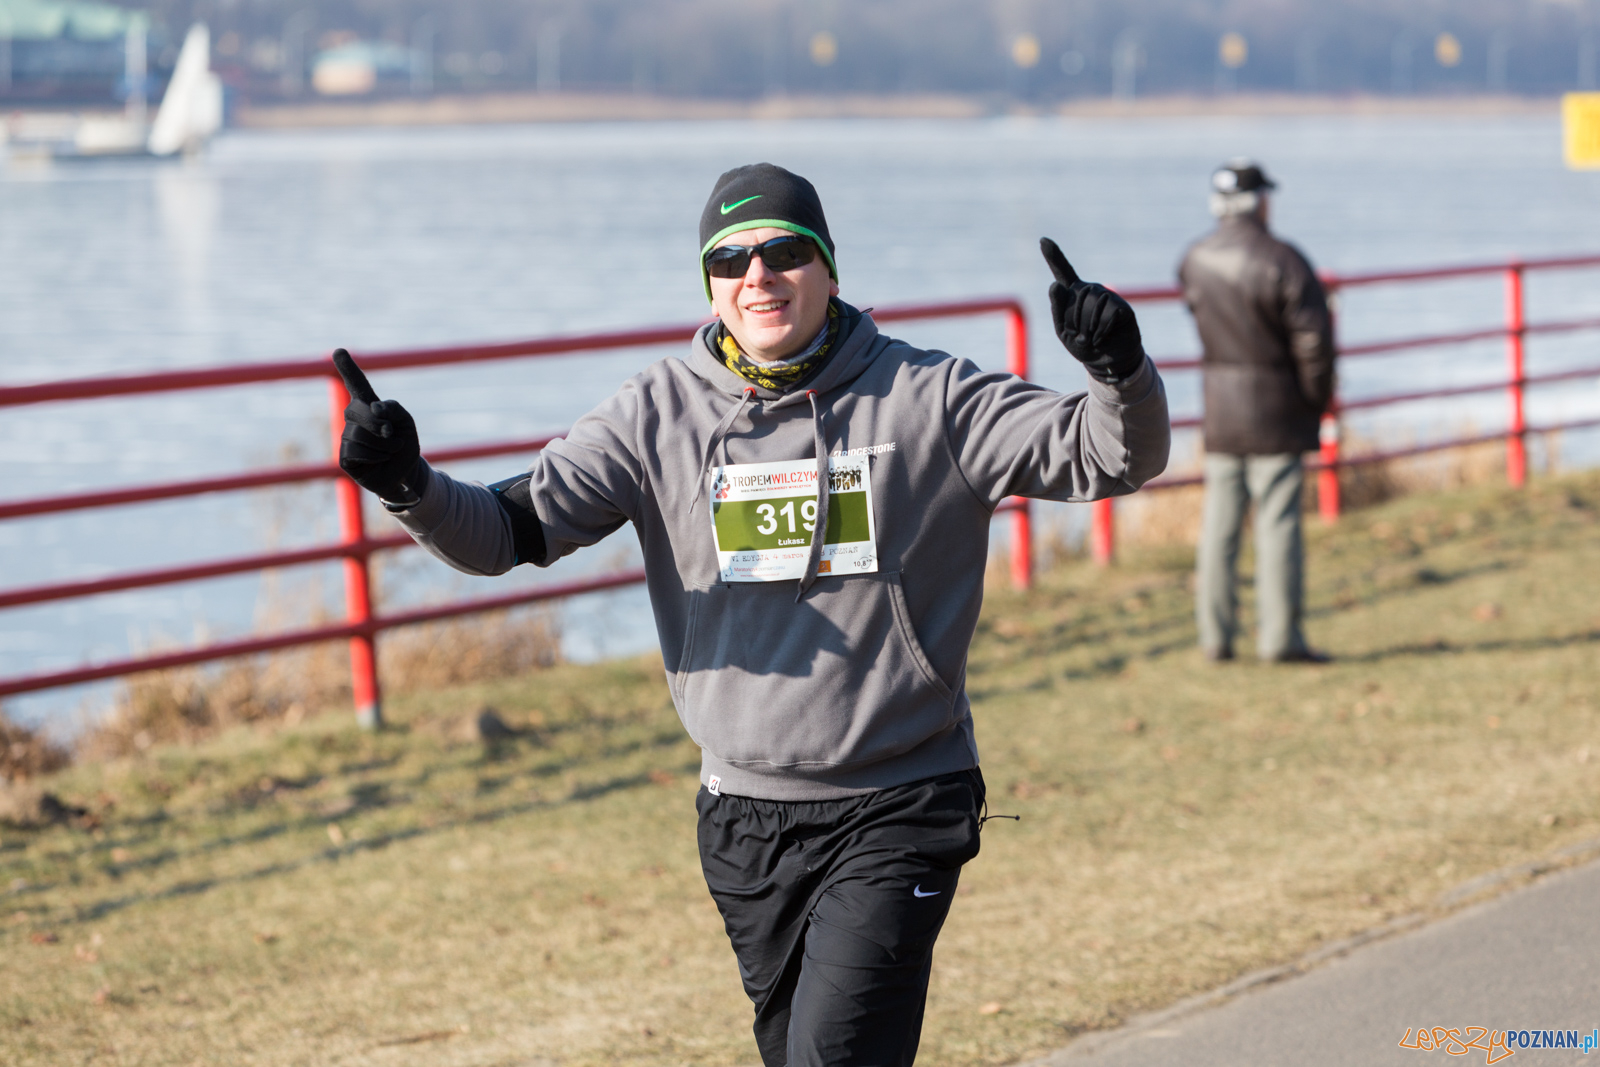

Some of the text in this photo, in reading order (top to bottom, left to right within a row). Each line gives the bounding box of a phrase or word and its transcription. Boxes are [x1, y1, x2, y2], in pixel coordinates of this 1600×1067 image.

[755, 499, 818, 535] 319
[777, 537, 805, 546] Łukasz
[742, 554, 769, 562] EDYCJA
[828, 546, 859, 556] POZNAŃ
